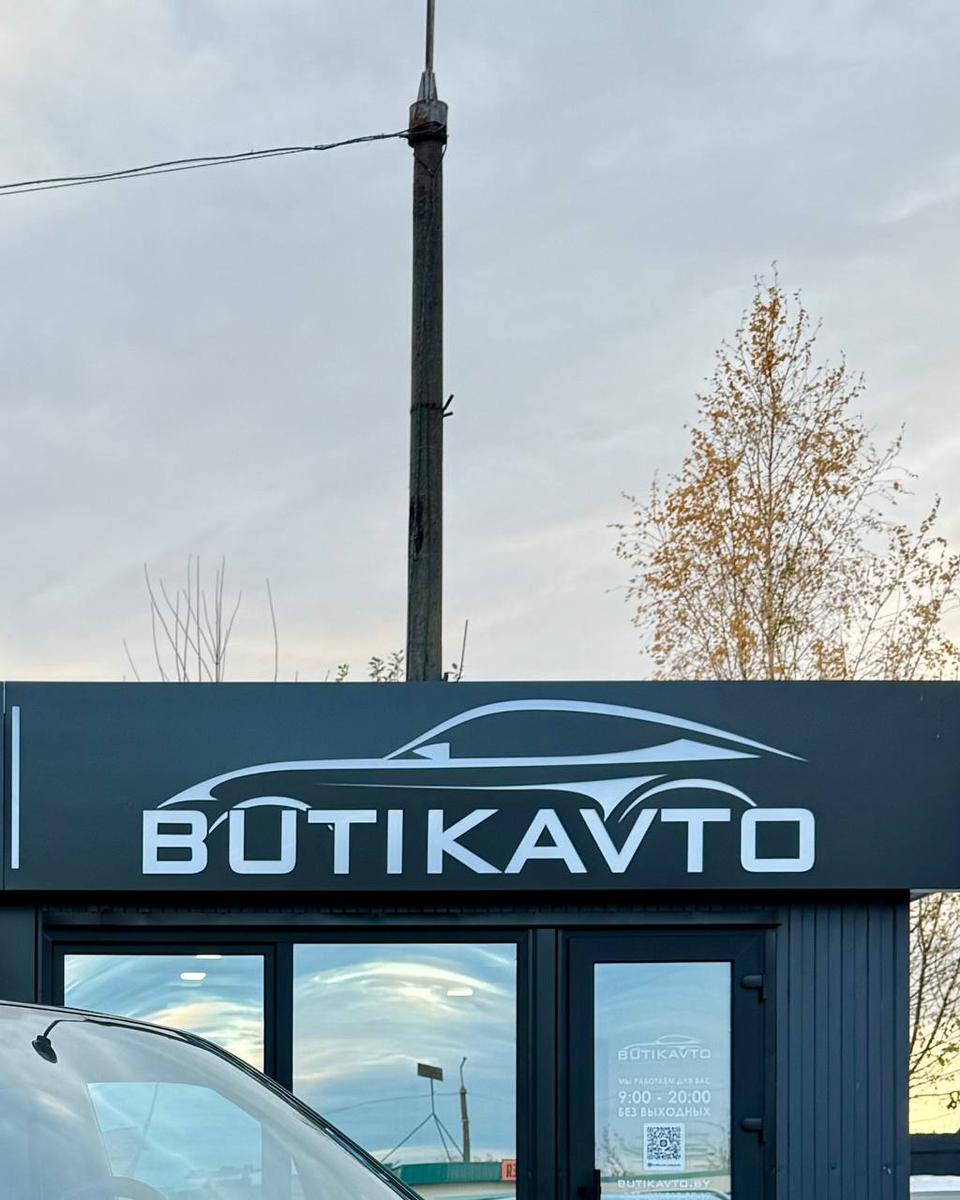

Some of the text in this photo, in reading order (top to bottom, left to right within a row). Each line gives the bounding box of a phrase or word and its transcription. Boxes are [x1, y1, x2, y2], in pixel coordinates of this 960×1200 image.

[141, 806, 816, 876] BUTIKAVTO
[617, 1048, 711, 1060] BUTIKAVTO
[618, 1090, 651, 1104] 9:00
[668, 1090, 712, 1104] 20:00
[617, 1106, 711, 1118] БЕЗ ВЫХОДНЫХ
[616, 1179, 711, 1189] BUTIKAVTO.BY
